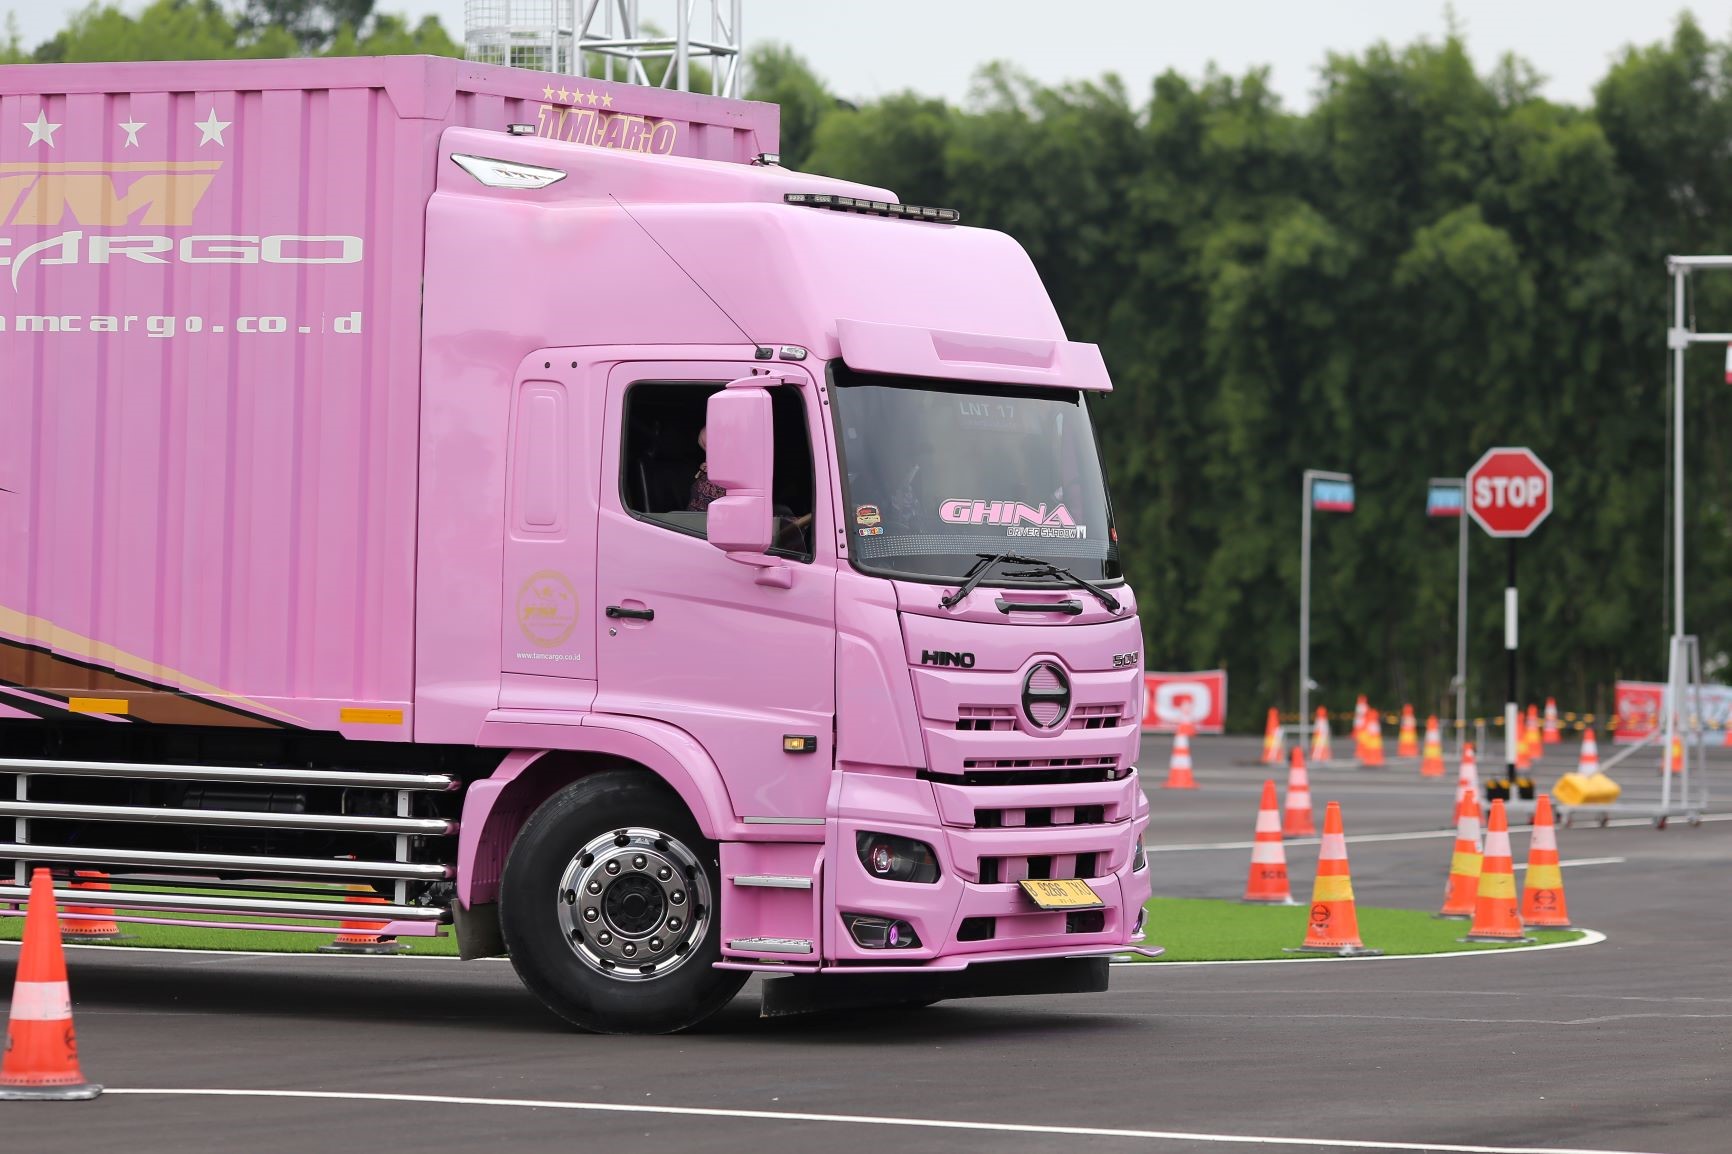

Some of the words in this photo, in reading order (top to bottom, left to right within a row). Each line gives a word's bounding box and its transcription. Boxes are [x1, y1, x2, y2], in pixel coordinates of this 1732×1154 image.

[0, 311, 362, 338] mcargo.co.d
[1474, 475, 1545, 508] STOP
[938, 498, 1077, 527] GHINA
[921, 650, 975, 669] HINO
[1112, 651, 1138, 669] 500
[1023, 882, 1038, 897] B
[1037, 882, 1069, 897] 9266
